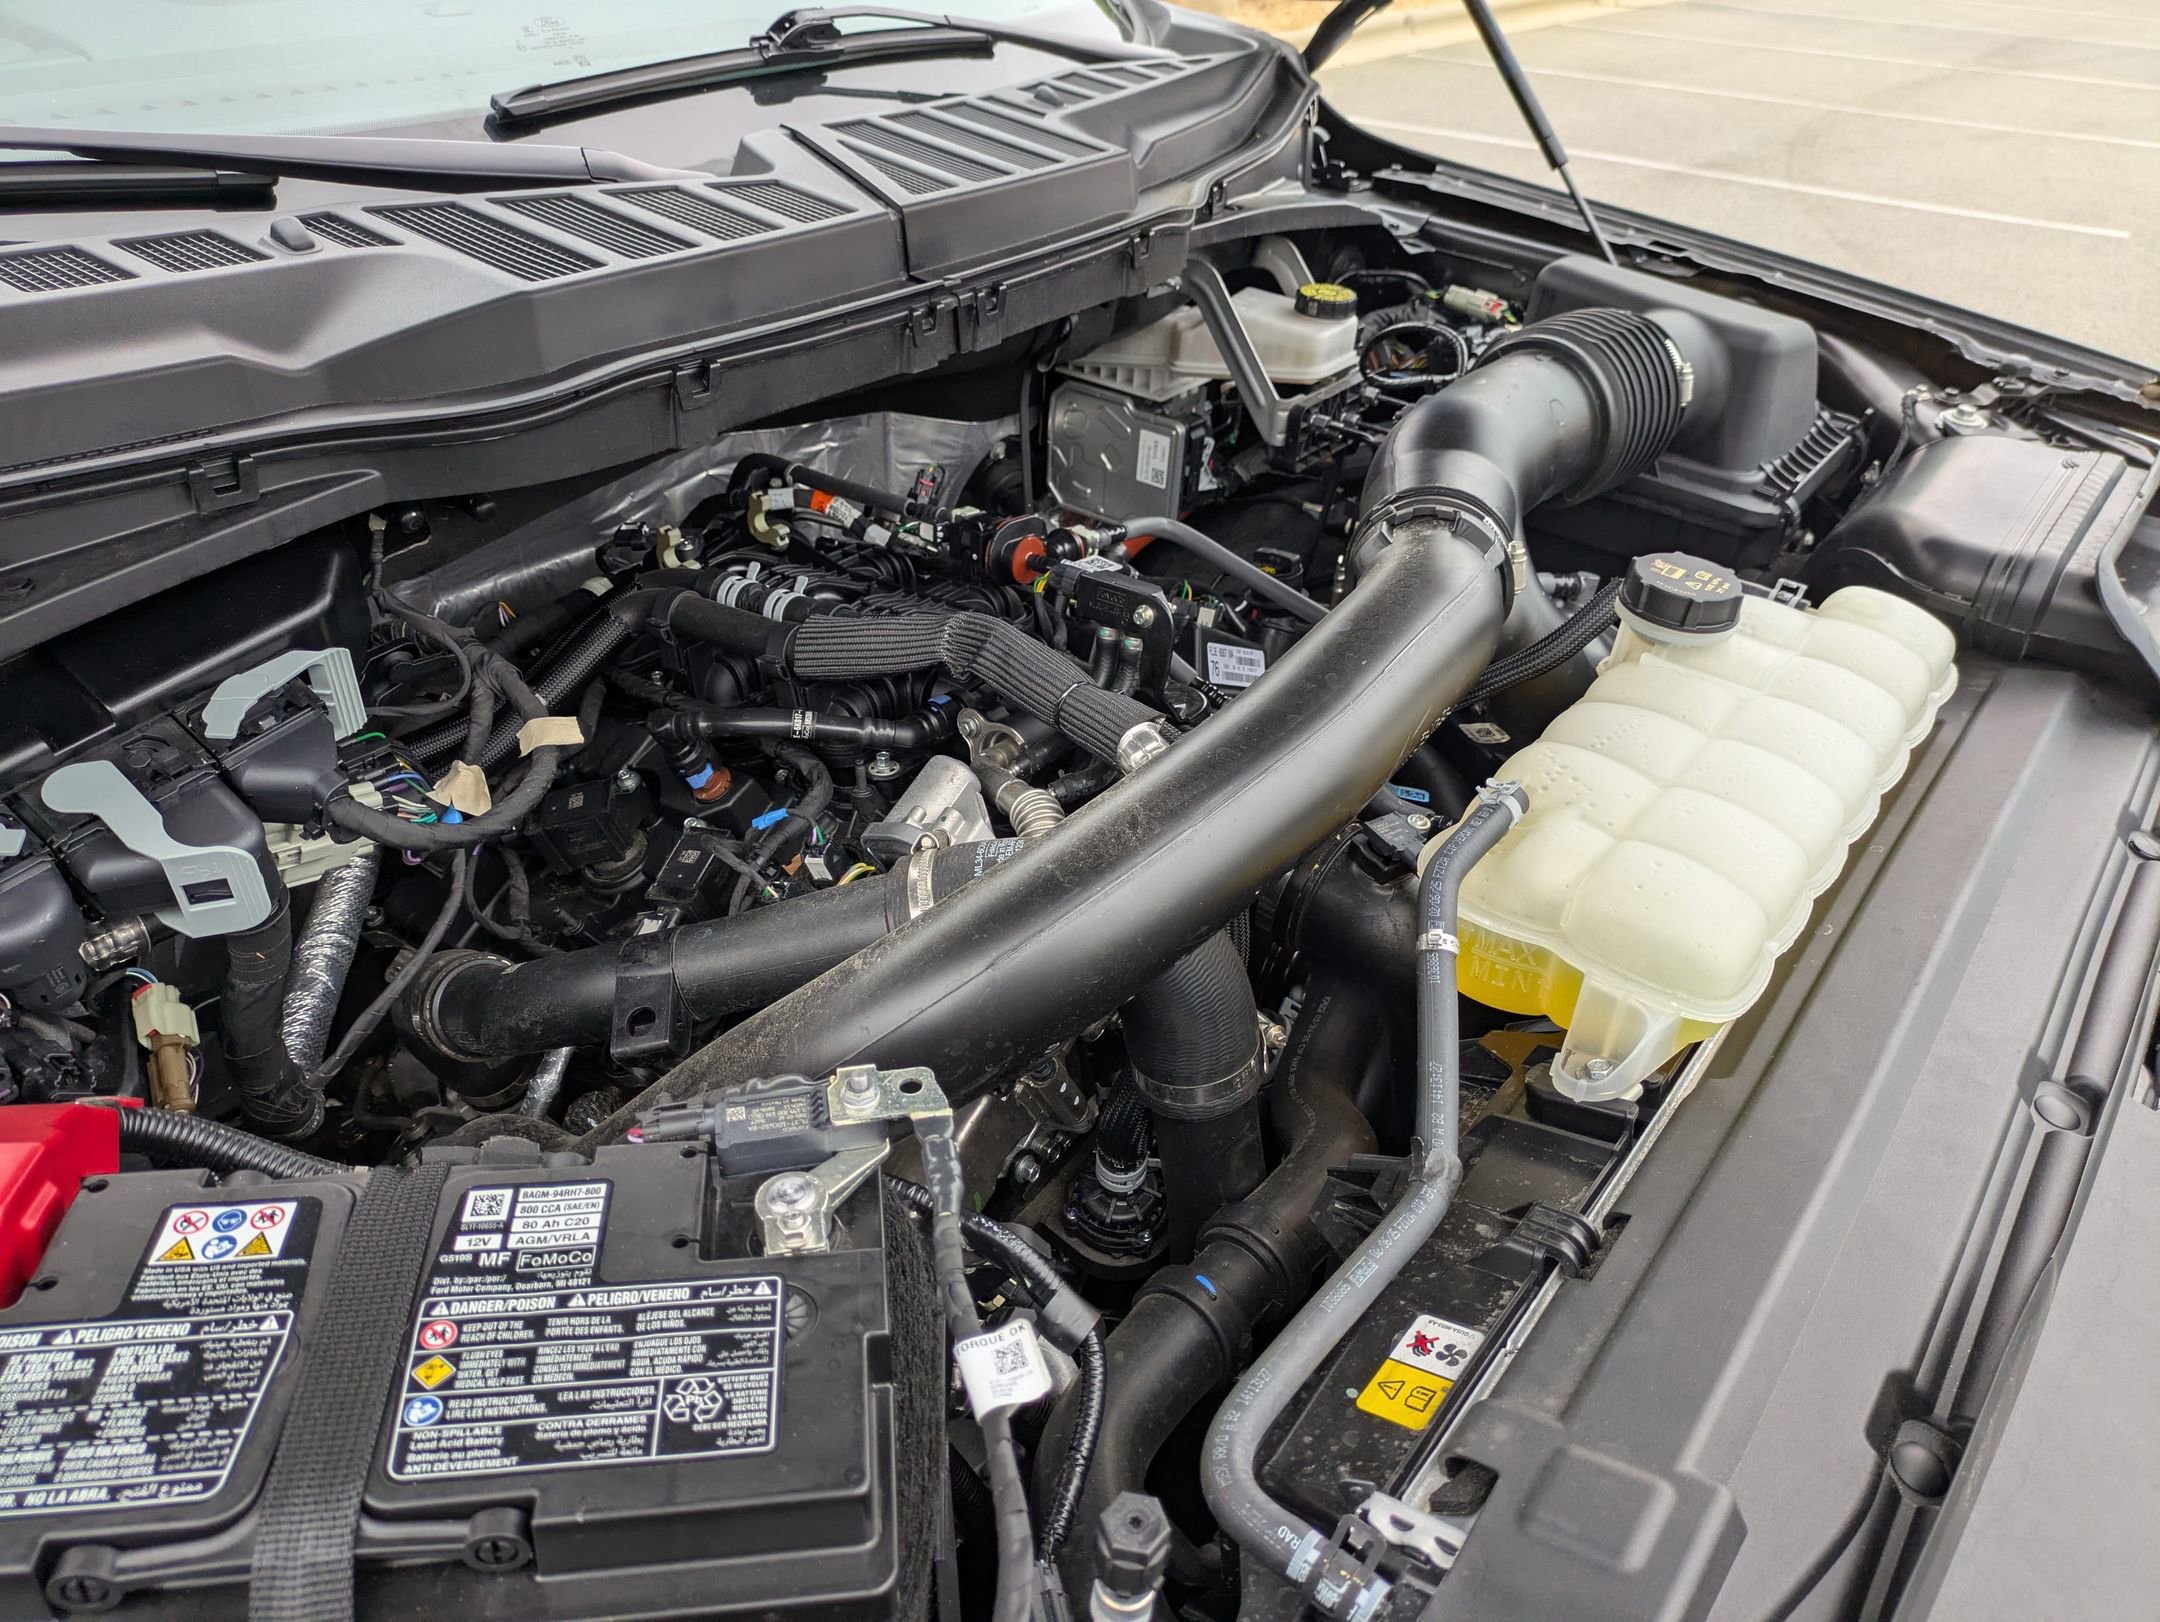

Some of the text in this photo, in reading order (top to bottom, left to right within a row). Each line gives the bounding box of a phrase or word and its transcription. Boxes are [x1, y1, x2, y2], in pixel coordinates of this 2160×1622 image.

[1475, 930, 1537, 967] MAX
[1470, 956, 1533, 993] MIN
[520, 1201, 600, 1214] 800 CCA (SAE/EN)
[522, 1217, 590, 1229] 80 Ah C20
[466, 1237, 492, 1247] 12V
[515, 1232, 591, 1245] AGM/VRLA
[477, 1251, 512, 1267] MF
[520, 1250, 593, 1268] FoMoCo
[144, 1266, 164, 1274] Made
[192, 1265, 209, 1273] with
[221, 1263, 236, 1271] and
[237, 1261, 270, 1271] imported
[188, 1284, 200, 1292] los
[230, 1281, 245, 1289] con
[430, 1286, 450, 1295] Ford
[451, 1285, 474, 1294] Motor
[475, 1282, 514, 1294] Company,
[555, 1279, 567, 1288] MI
[567, 1278, 591, 1287] 48121
[587, 1287, 690, 1306] PELIGRO/VENENO
[450, 1296, 557, 1315] DANGER/POISON
[668, 1309, 682, 1319] DEL
[682, 1307, 715, 1319] ALCANCE
[462, 1320, 524, 1333] KEEP OUT OF THE
[547, 1315, 611, 1327] TENIR HORS DE LA
[635, 1323, 647, 1332] DE
[648, 1321, 662, 1331] LOS
[75, 1323, 191, 1343] PELIGRO/VENENO
[574, 1325, 587, 1336] DES
[589, 1323, 624, 1335] ENFANTS.
[1009, 1322, 1026, 1336] OK
[460, 1330, 535, 1344] REACH OF CHILDREN.
[633, 1335, 701, 1349] ENJUAGUE LOS OJOS
[157, 1343, 176, 1354] LOS
[462, 1350, 504, 1360] FLUSH EYES
[562, 1345, 576, 1353] LES
[576, 1344, 594, 1353] YEUX
[632, 1344, 707, 1358] INMEDIATAMENTE CON
[139, 1354, 158, 1365] LOS
[158, 1350, 190, 1362] GASES
[459, 1357, 526, 1369] IMMEDIATELY WITH
[653, 1355, 677, 1365] ACUDA
[485, 1368, 500, 1377] GET
[533, 1363, 572, 1374] CONSULTER
[629, 1366, 654, 1377] CON EL
[454, 1378, 486, 1389] MEDICAL
[487, 1377, 505, 1387] HELP
[531, 1375, 543, 1383] UN
[749, 1374, 769, 1382] MUST
[557, 1385, 657, 1402] LEA LAS INSTRUCCIONES.
[725, 1391, 734, 1399] LA
[448, 1394, 537, 1408] READ INSTRUCTIONS.
[686, 1395, 703, 1406] Pb
[445, 1403, 548, 1420] LIRE LES INSTRUCTIONS.
[727, 1413, 736, 1421] LA
[536, 1415, 647, 1431] CONTRA DERRAMES
[412, 1426, 503, 1440] NON-SPILLABLE
[571, 1429, 581, 1438] de
[583, 1426, 612, 1438] plomo
[409, 1436, 504, 1451] Lead Acid Battery
[406, 1447, 501, 1463] Batterie au plomb
[403, 1462, 432, 1474] ANTI
[24, 1491, 47, 1506] NO
[47, 1489, 68, 1505] LA
[1277, 1525, 1303, 1550] RAD
